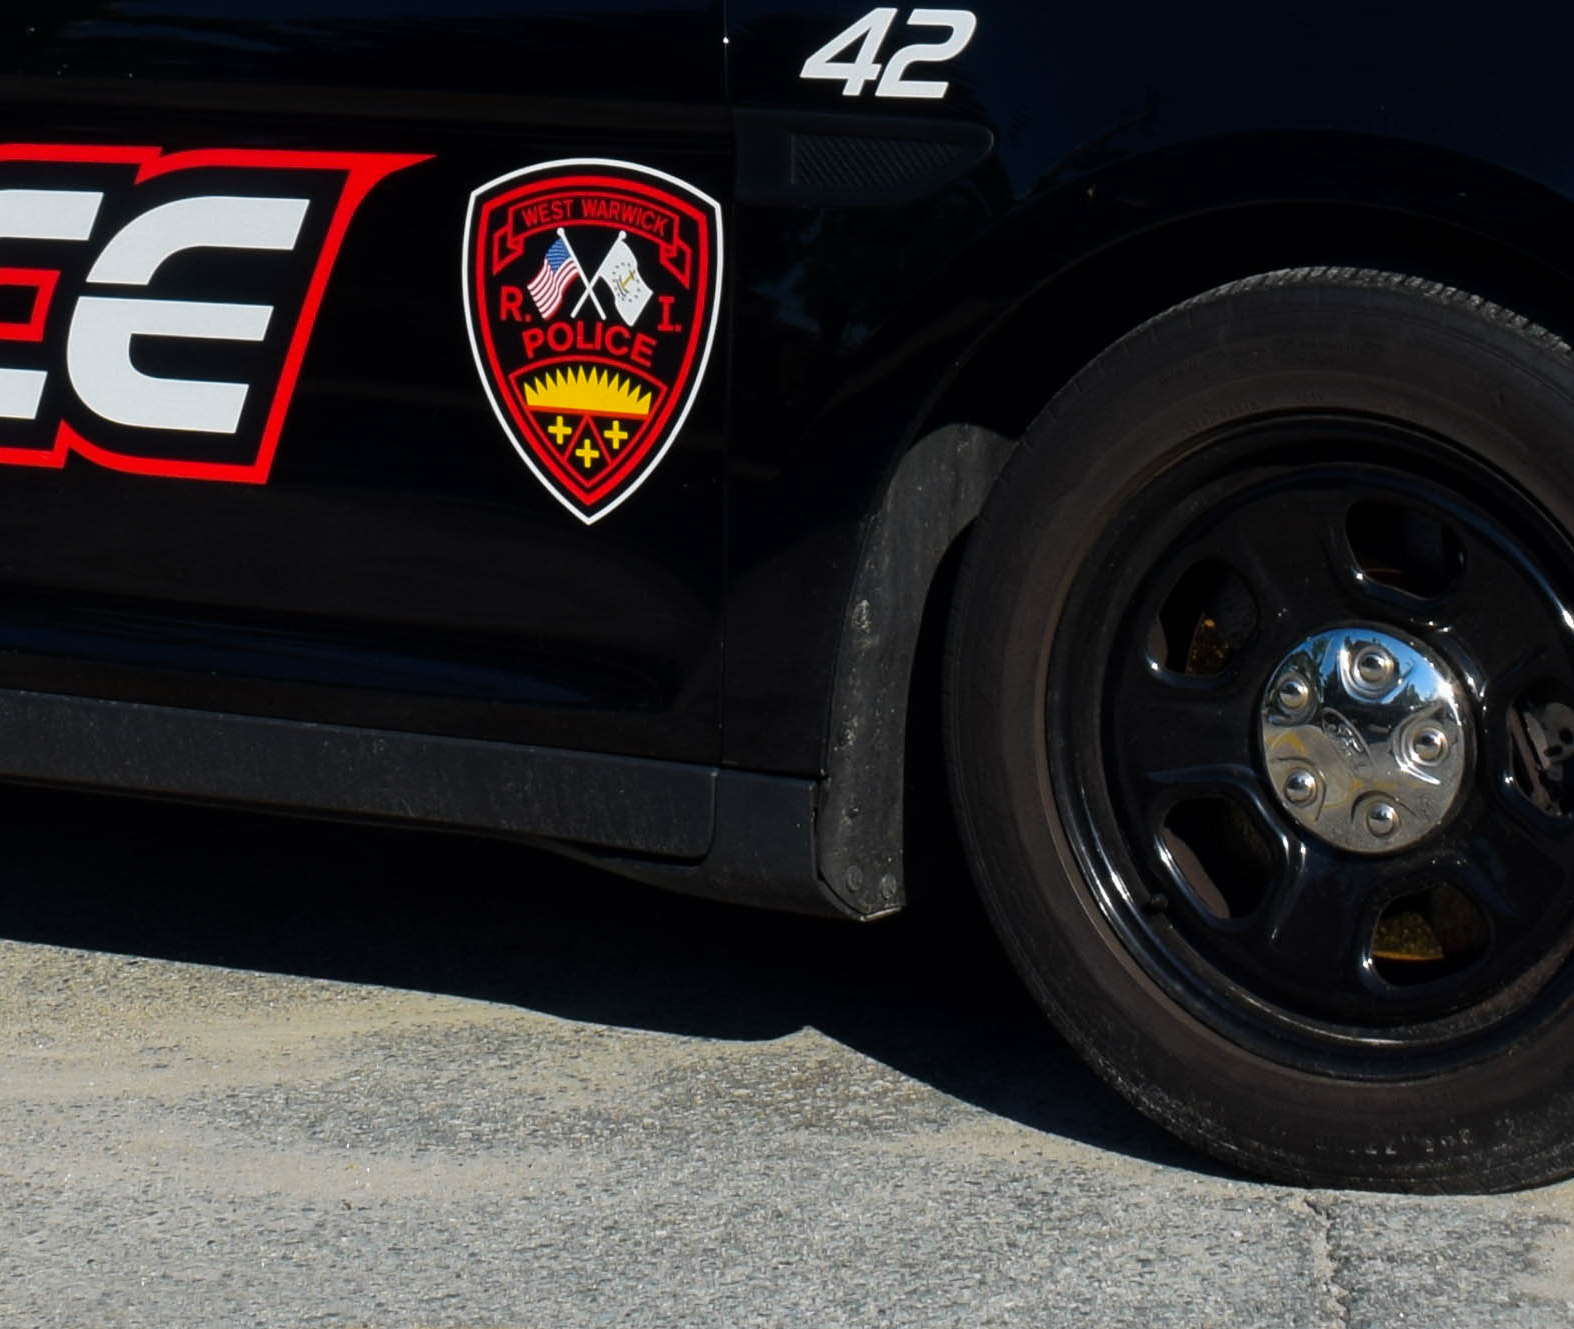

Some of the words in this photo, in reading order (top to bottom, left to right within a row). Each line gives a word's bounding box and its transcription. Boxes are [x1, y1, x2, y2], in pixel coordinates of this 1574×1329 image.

[799, 7, 977, 99] 42
[521, 198, 574, 228] WEST
[581, 198, 669, 237] WARWICK
[500, 285, 532, 322] R.
[657, 295, 682, 332] I.
[522, 320, 658, 368] POLICE
